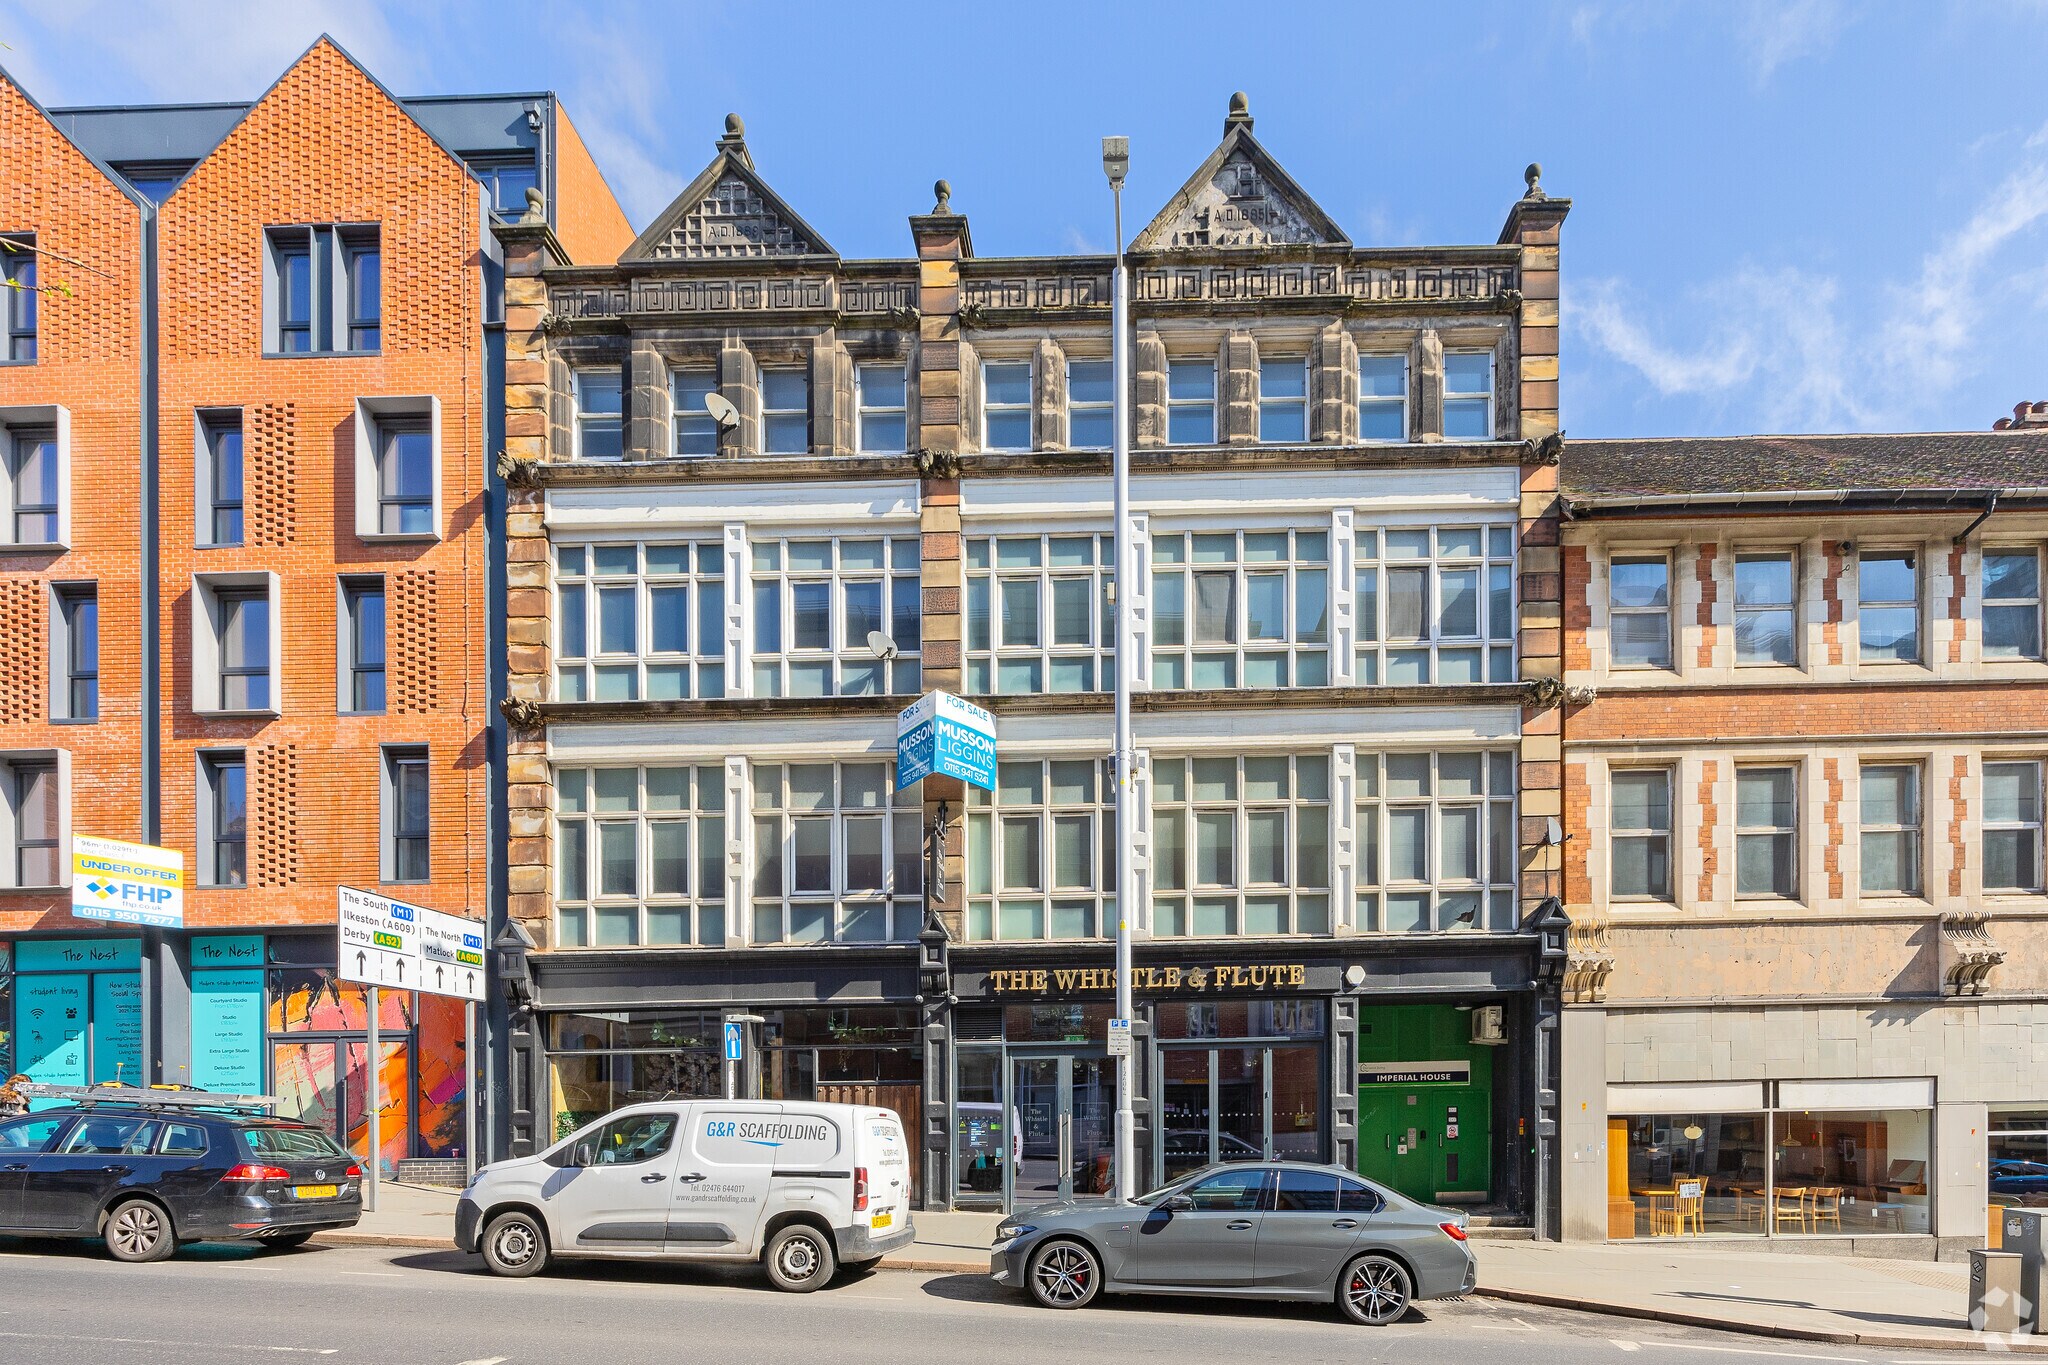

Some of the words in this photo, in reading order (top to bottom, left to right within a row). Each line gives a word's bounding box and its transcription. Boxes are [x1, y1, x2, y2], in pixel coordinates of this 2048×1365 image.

[902, 706, 914, 721] FOR
[946, 695, 965, 711] FOR
[968, 704, 988, 722] SALE
[899, 722, 934, 754] MUSSON
[938, 720, 994, 755] MUSSON
[898, 739, 934, 770] LIGGINS
[938, 736, 994, 770] LIGGINS
[944, 762, 960, 774] 0115
[961, 768, 974, 778] 941
[974, 772, 989, 784] 5241
[81, 860, 131, 874] UNDER
[134, 867, 177, 880] OFFER
[122, 884, 172, 904] FHP
[122, 901, 162, 910] fhp.co.uk
[343, 892, 360, 904] The
[362, 898, 389, 912] South
[392, 904, 414, 920] (M1)
[82, 908, 111, 918] 0115
[114, 911, 140, 920] 950
[142, 914, 174, 925] 7577
[344, 910, 380, 926] Ilkeston
[382, 918, 416, 936] (A609)
[344, 928, 371, 942] Derby
[374, 931, 402, 949] (A52)
[426, 927, 439, 938] The
[441, 930, 462, 942] North
[464, 934, 482, 948] (M1)
[62, 948, 84, 962] The
[90, 947, 120, 961] Nest
[200, 944, 222, 958] The
[228, 944, 259, 958] Nest
[426, 944, 454, 958] Matlock
[456, 950, 482, 965] (A610)
[990, 970, 1048, 991] THE
[1188, 966, 1206, 988] &
[1214, 964, 1306, 987] FLUTE
[30, 987, 58, 996] student
[61, 987, 79, 998] living
[706, 1121, 735, 1137] G&R
[739, 1122, 827, 1140] SCAFFOLDING
[702, 1184, 721, 1192] 02476
[722, 1185, 745, 1193] 644017
[676, 1195, 757, 1204] www.gandrscaffolding.co.uk
